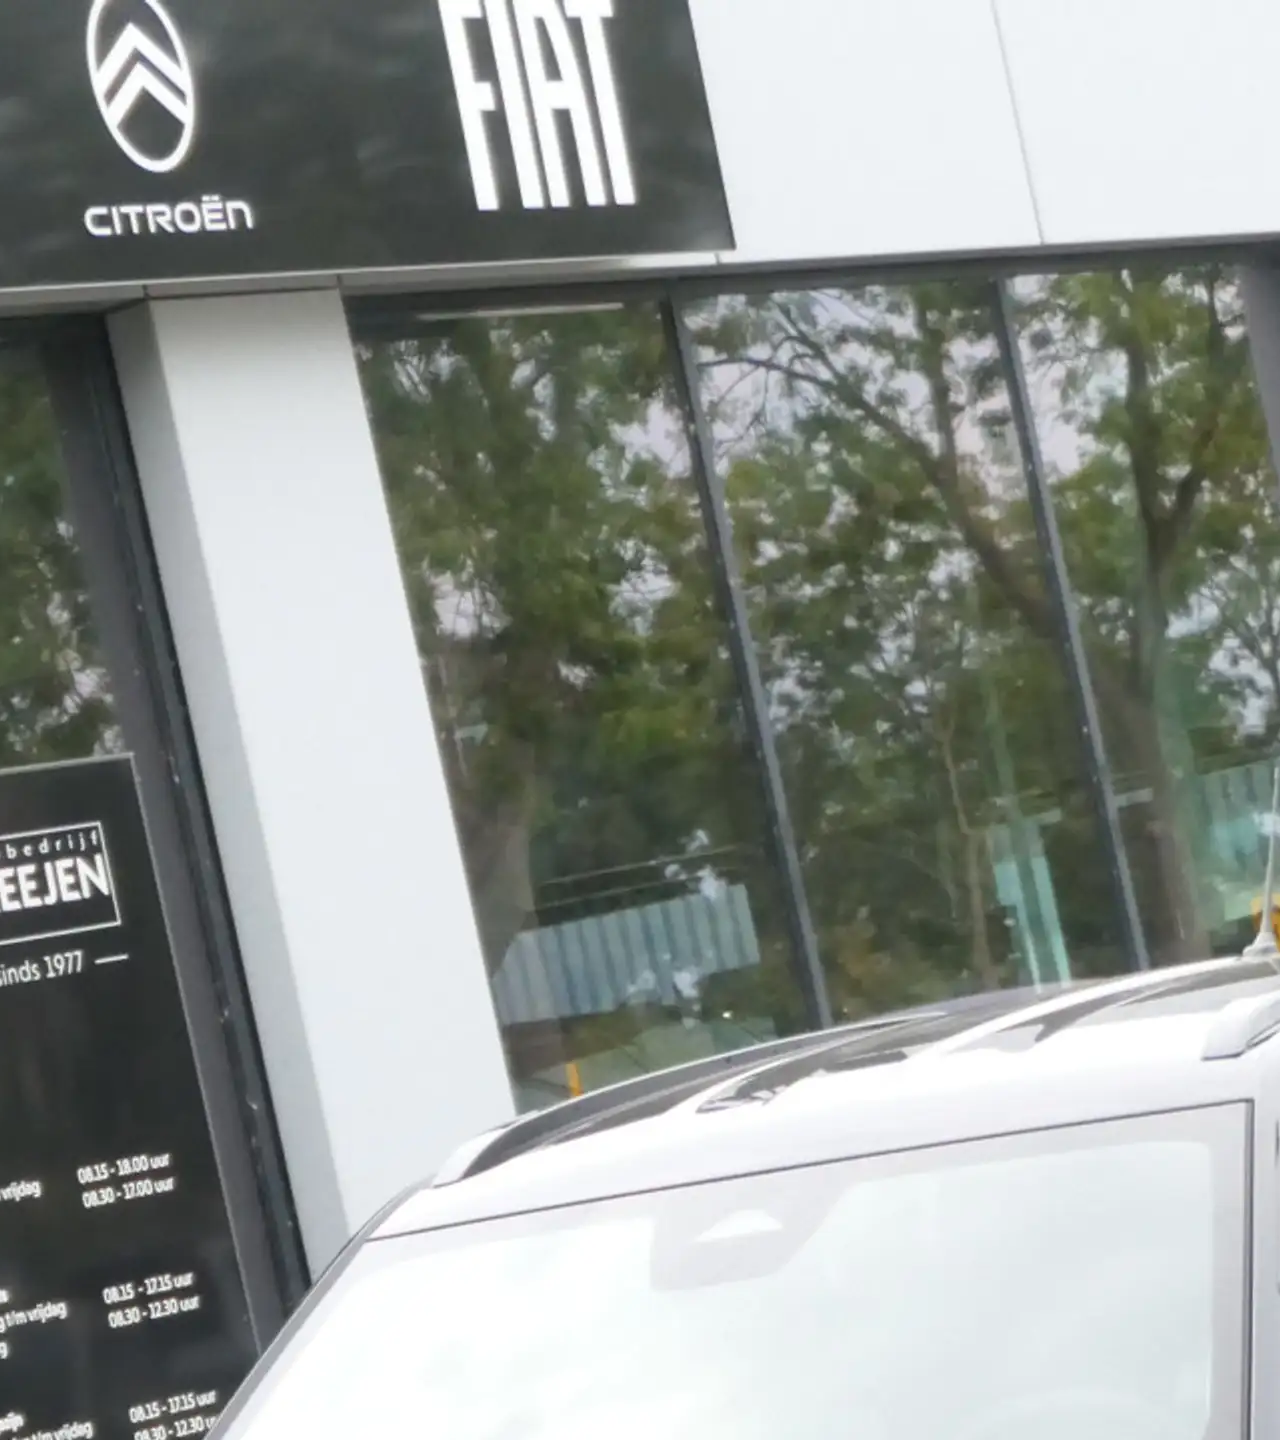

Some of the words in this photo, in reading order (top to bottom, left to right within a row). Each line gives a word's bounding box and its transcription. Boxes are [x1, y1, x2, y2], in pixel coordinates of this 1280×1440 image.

[437, 0, 637, 211] FIAT
[83, 194, 255, 237] CITROËN
[45, 950, 84, 979] 1977
[0, 1180, 42, 1202] vrijdag
[149, 1152, 171, 1170] uur
[153, 1176, 175, 1194] uur
[27, 1301, 67, 1324] vrijdag
[173, 1271, 194, 1289] uur
[179, 1295, 200, 1313] uur
[196, 1389, 217, 1407] uur
